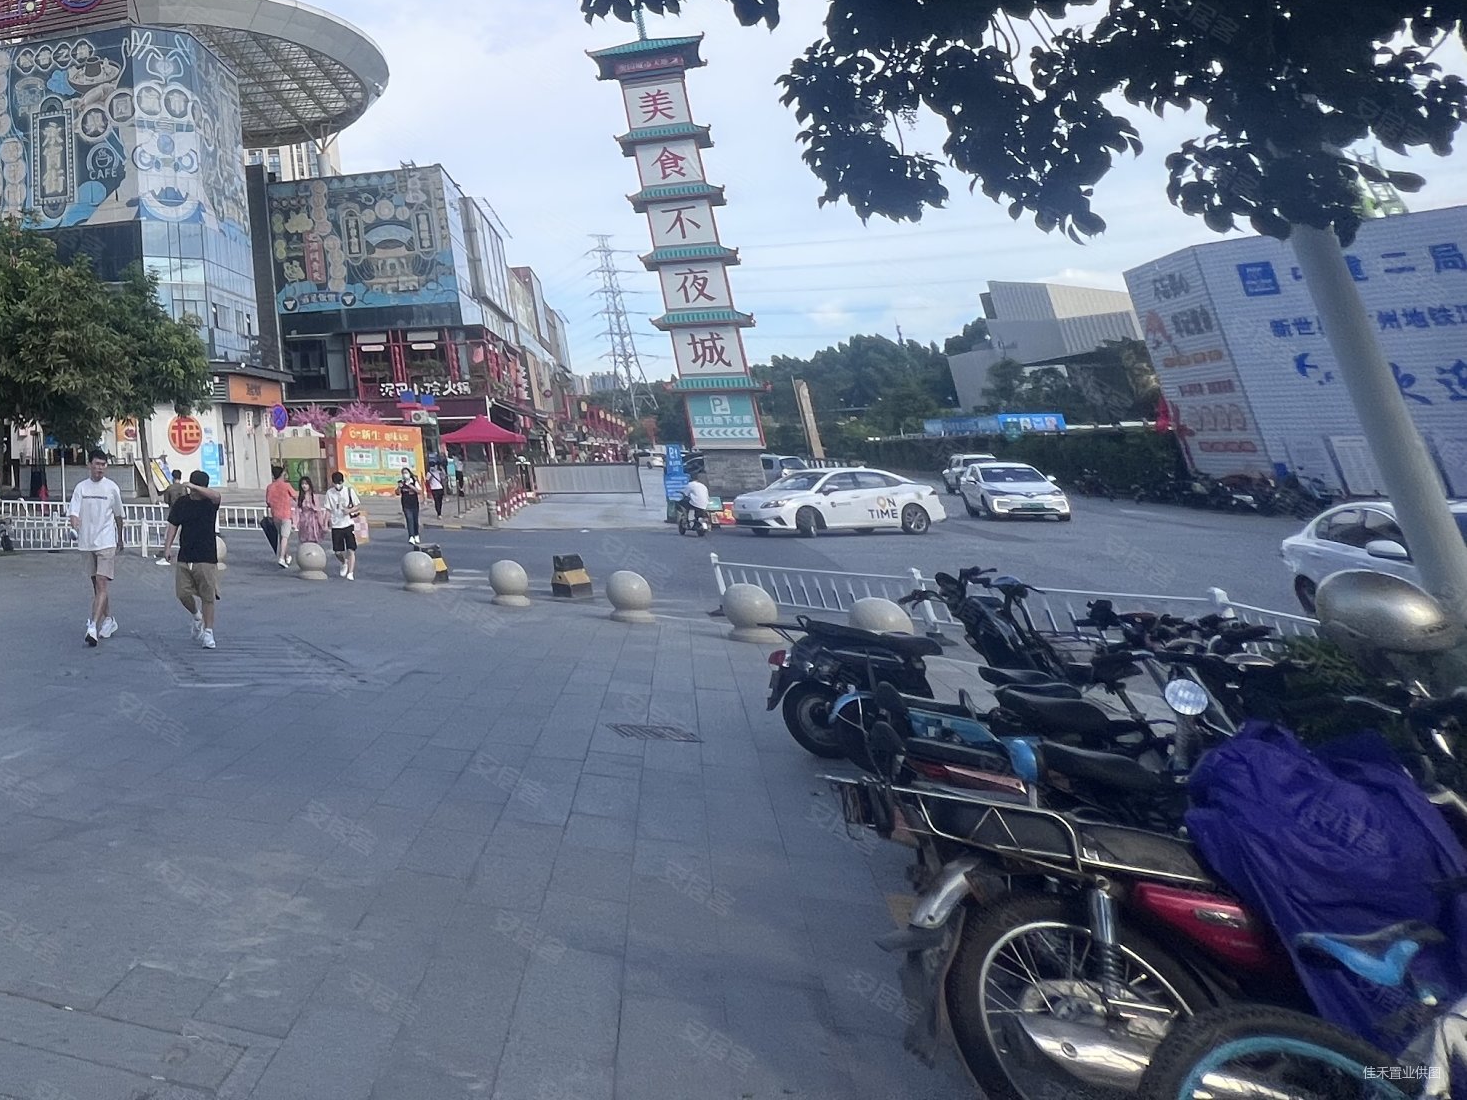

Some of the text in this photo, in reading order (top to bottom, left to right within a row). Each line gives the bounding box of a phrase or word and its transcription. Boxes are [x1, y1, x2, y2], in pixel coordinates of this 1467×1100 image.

[89, 168, 118, 180] CAFE
[638, 89, 733, 368] 美食不夜城
[1291, 243, 1467, 283] 建二局
[868, 508, 899, 520] TIME
